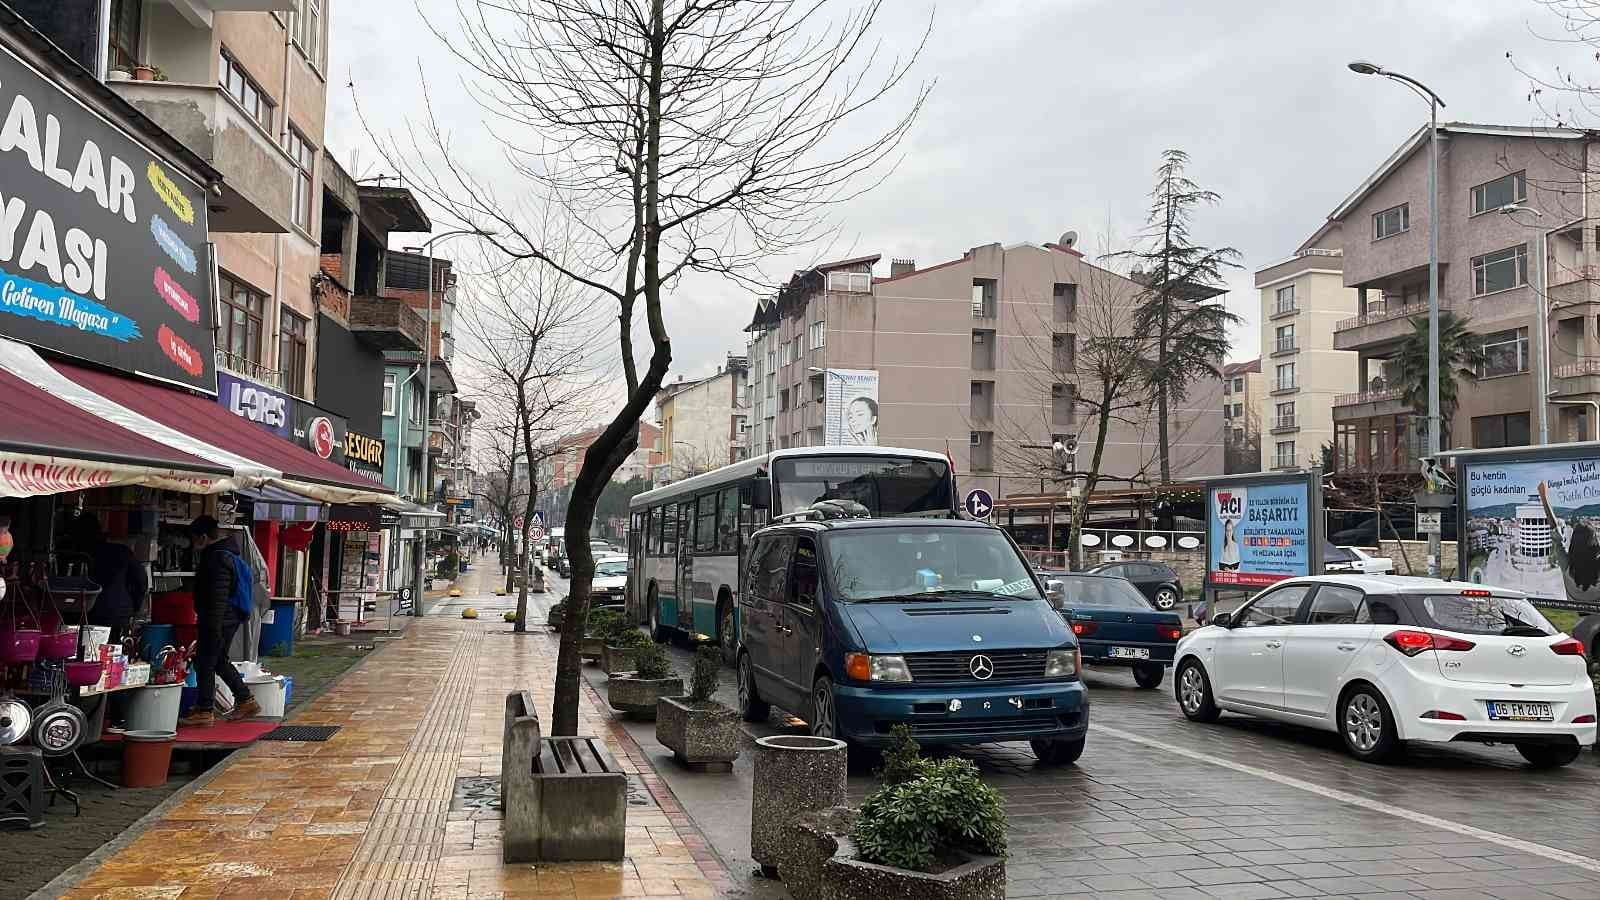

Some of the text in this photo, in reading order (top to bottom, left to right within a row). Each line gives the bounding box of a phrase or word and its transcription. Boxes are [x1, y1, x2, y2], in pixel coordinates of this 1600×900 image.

[0, 80, 137, 223] ALAR
[2, 279, 55, 315] Getiren
[1571, 461, 1596, 474] 8 Mart
[1470, 471, 1507, 481] Bu kentin
[1220, 497, 1242, 514] AÇI
[1249, 507, 1298, 525] BAŞARIYI
[531, 529, 541, 538] 30
[1495, 703, 1550, 716] 06 FM 2079
